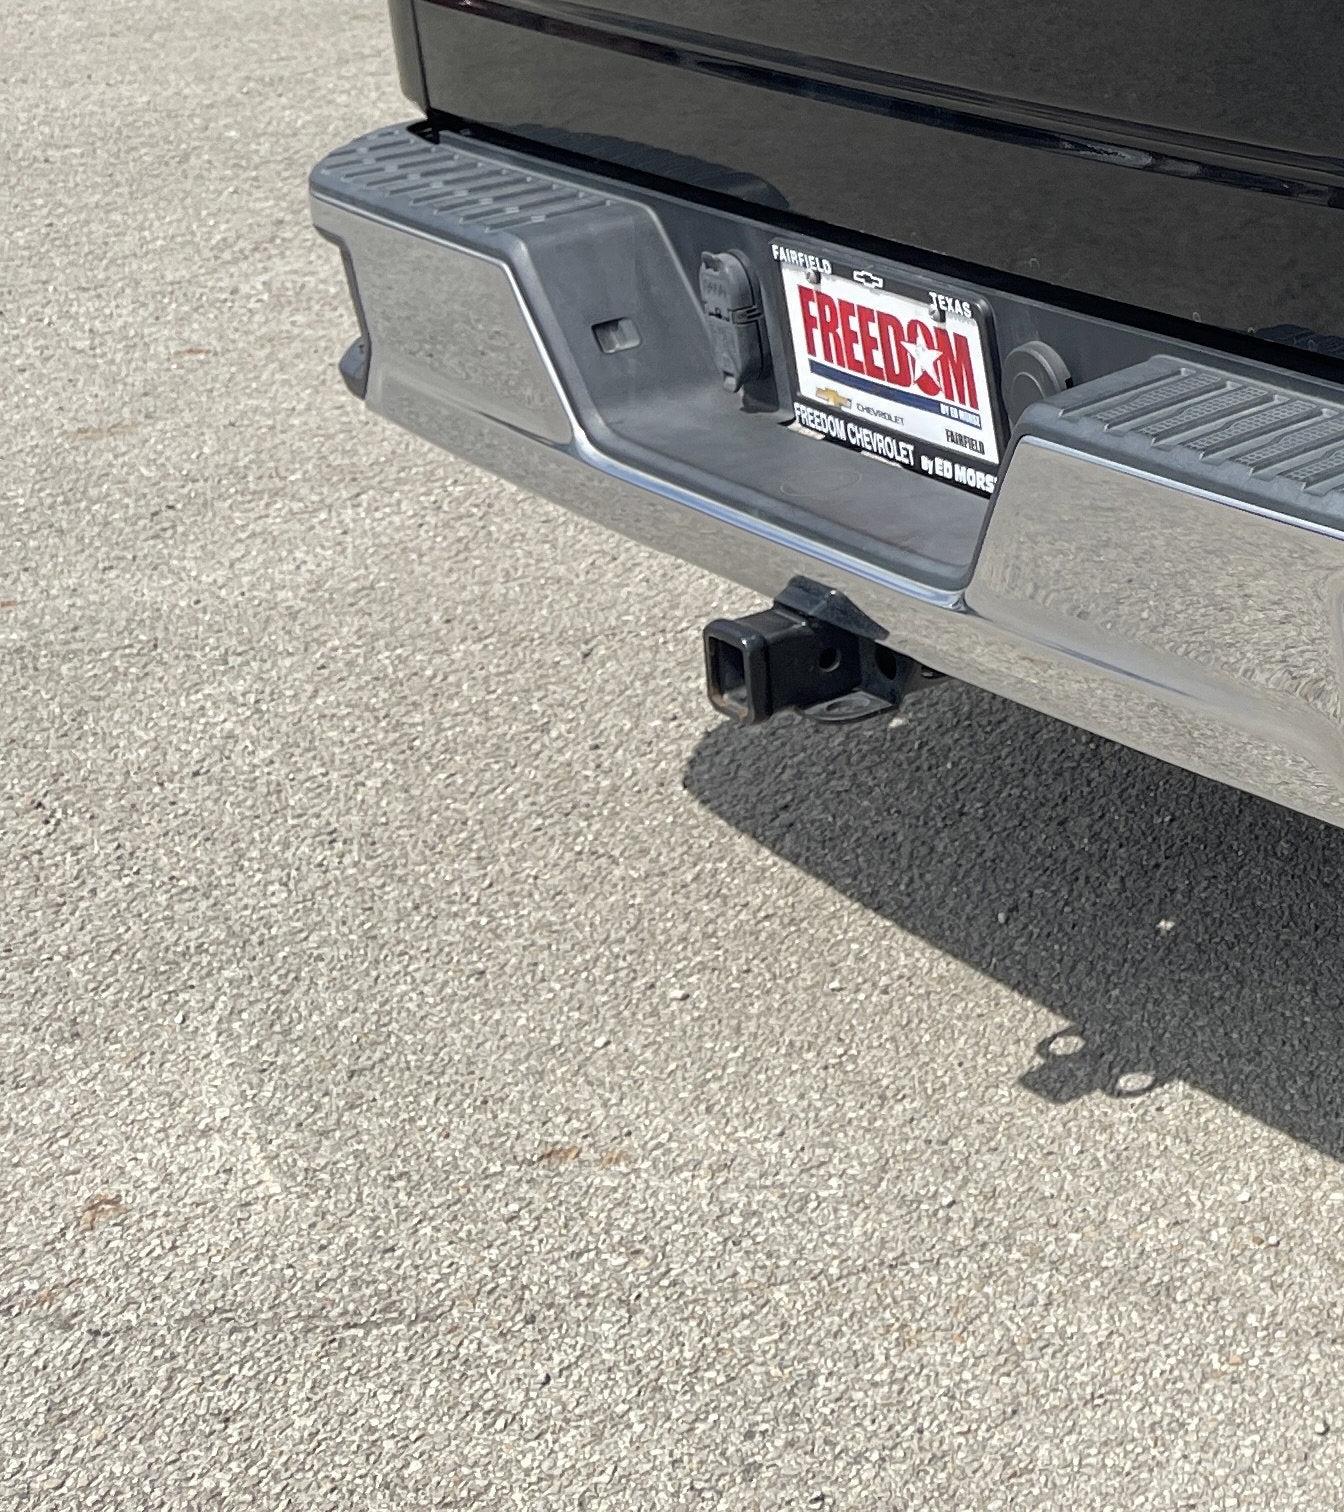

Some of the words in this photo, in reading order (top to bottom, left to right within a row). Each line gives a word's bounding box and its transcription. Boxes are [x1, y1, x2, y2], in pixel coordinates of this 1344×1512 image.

[771, 244, 832, 275] FAIRFIELD
[929, 291, 972, 318] TEXAS
[798, 285, 979, 409] FREEDOM
[856, 403, 905, 426] CHEVROLET
[794, 402, 846, 441] FREEDOM
[847, 423, 915, 466] CHEVROLET
[934, 457, 954, 480] ED
[945, 429, 985, 455] FAIRFIELD
